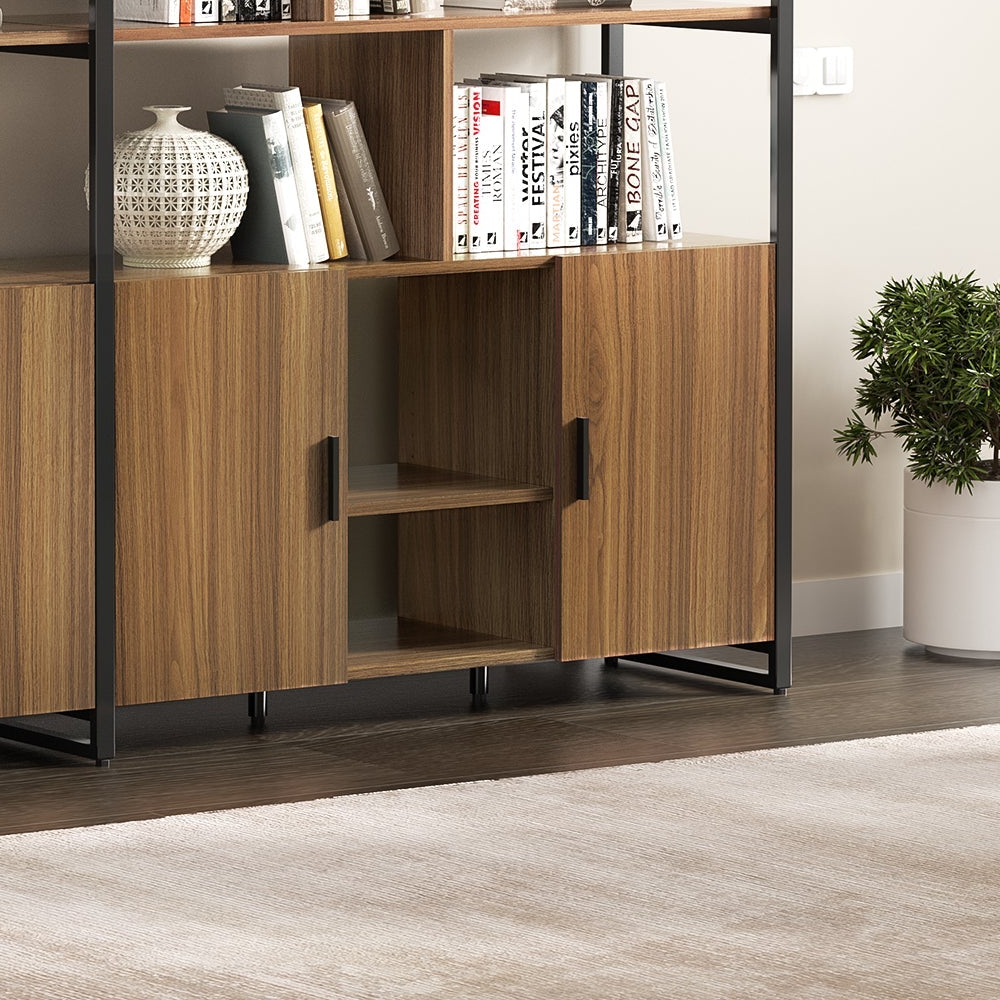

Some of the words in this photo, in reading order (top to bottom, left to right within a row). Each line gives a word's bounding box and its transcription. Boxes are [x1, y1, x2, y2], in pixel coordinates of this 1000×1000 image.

[472, 91, 480, 136] VISION
[625, 83, 641, 132] GAP
[492, 144, 502, 202] ROMAN
[531, 111, 545, 206] FESTIVAL
[565, 121, 581, 176] pixies
[596, 118, 608, 208] ARCHITYPE
[627, 141, 641, 205] BONE
[552, 184, 561, 243] MARTIAN
